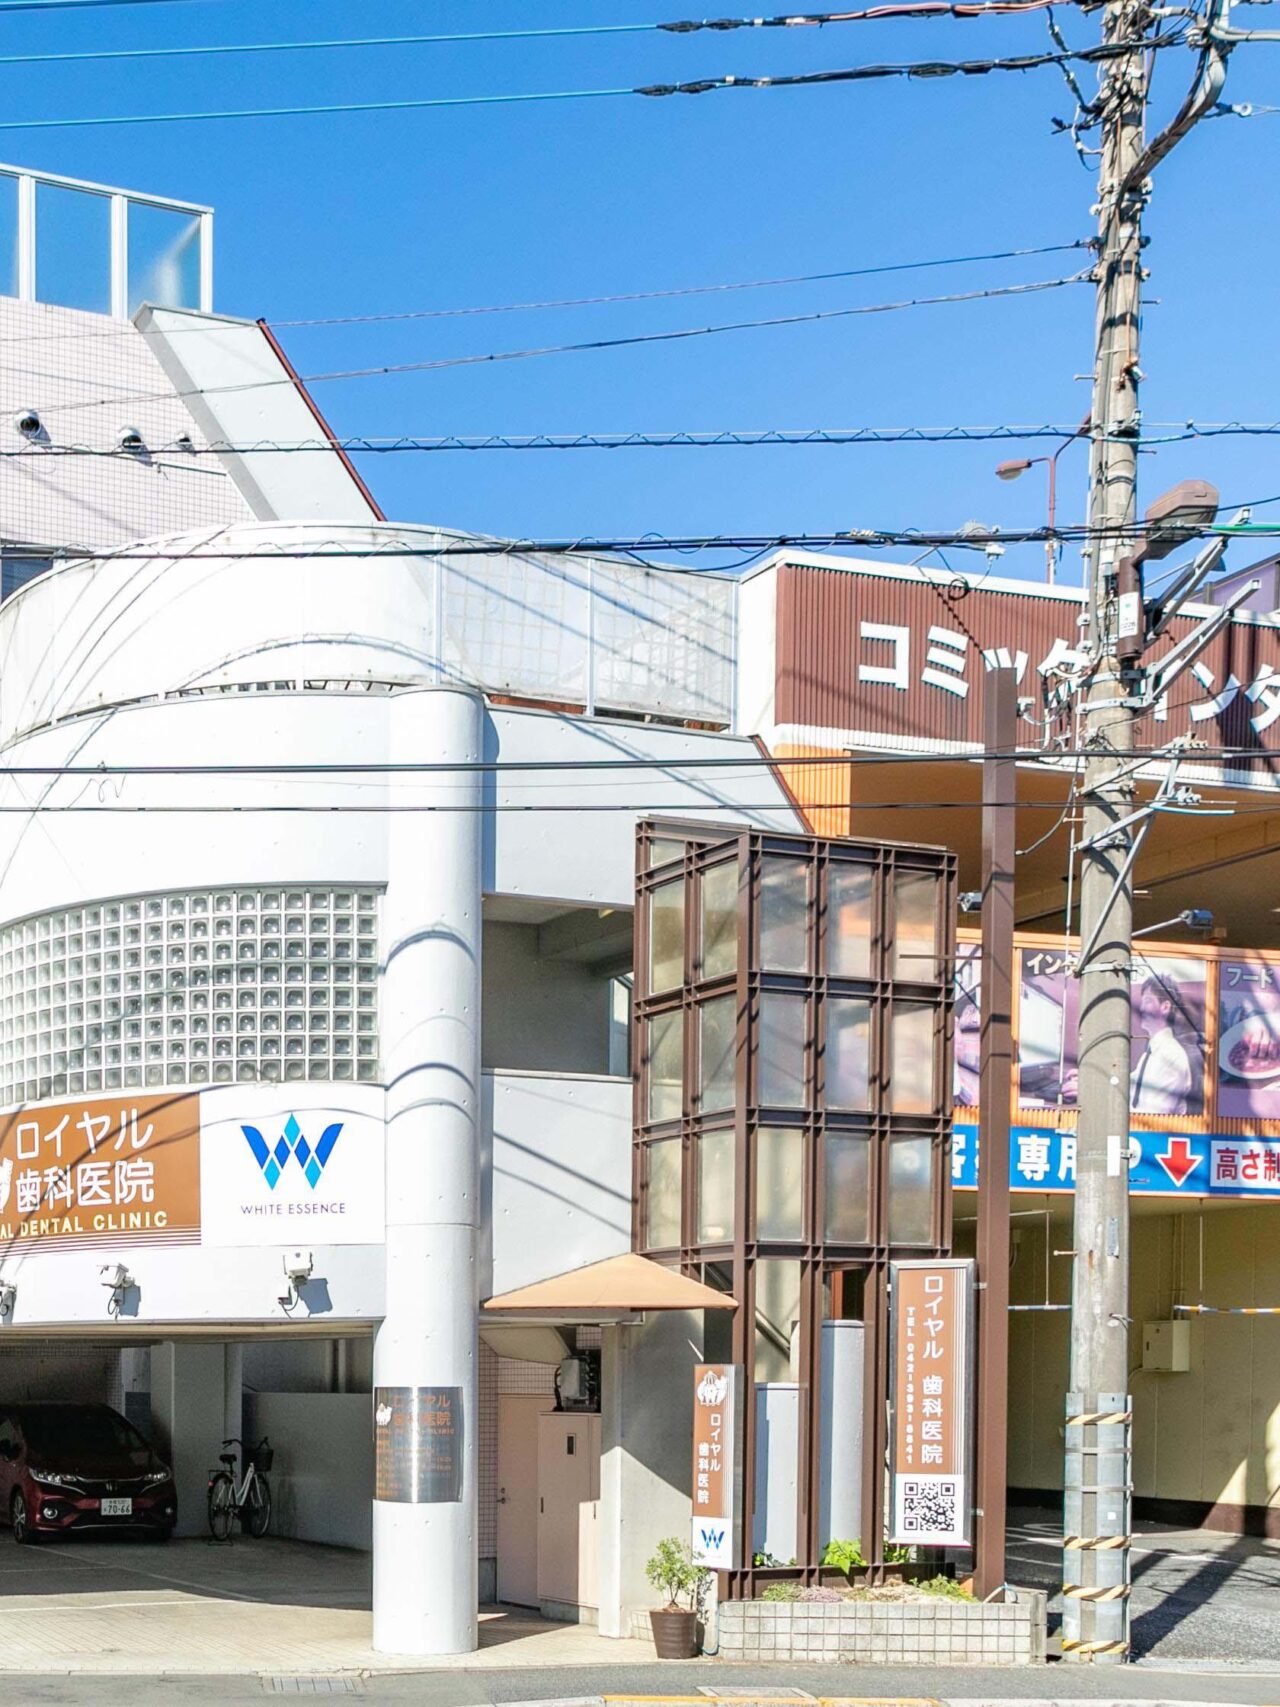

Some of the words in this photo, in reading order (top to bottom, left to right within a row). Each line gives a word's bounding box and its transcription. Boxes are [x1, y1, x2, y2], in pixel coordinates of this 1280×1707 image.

[1226, 967, 1273, 989] フード
[16, 1107, 154, 1160] ロイヤル
[15, 1157, 155, 1213] 歯科医院
[1216, 1147, 1280, 1182] 高さ制
[19, 1215, 84, 1237] DENTAL
[93, 1210, 167, 1231] CLINIC
[240, 1203, 283, 1216] WHITE
[288, 1202, 346, 1215] ESSENCE
[906, 1306, 916, 1337] TEL
[923, 1275, 944, 1360] ロイヤル
[921, 1374, 944, 1464] 歯科医院
[710, 1413, 721, 1472] ロイヤル
[697, 1442, 710, 1505] 歯科医院
[108, 1504, 130, 1514] 70-66
